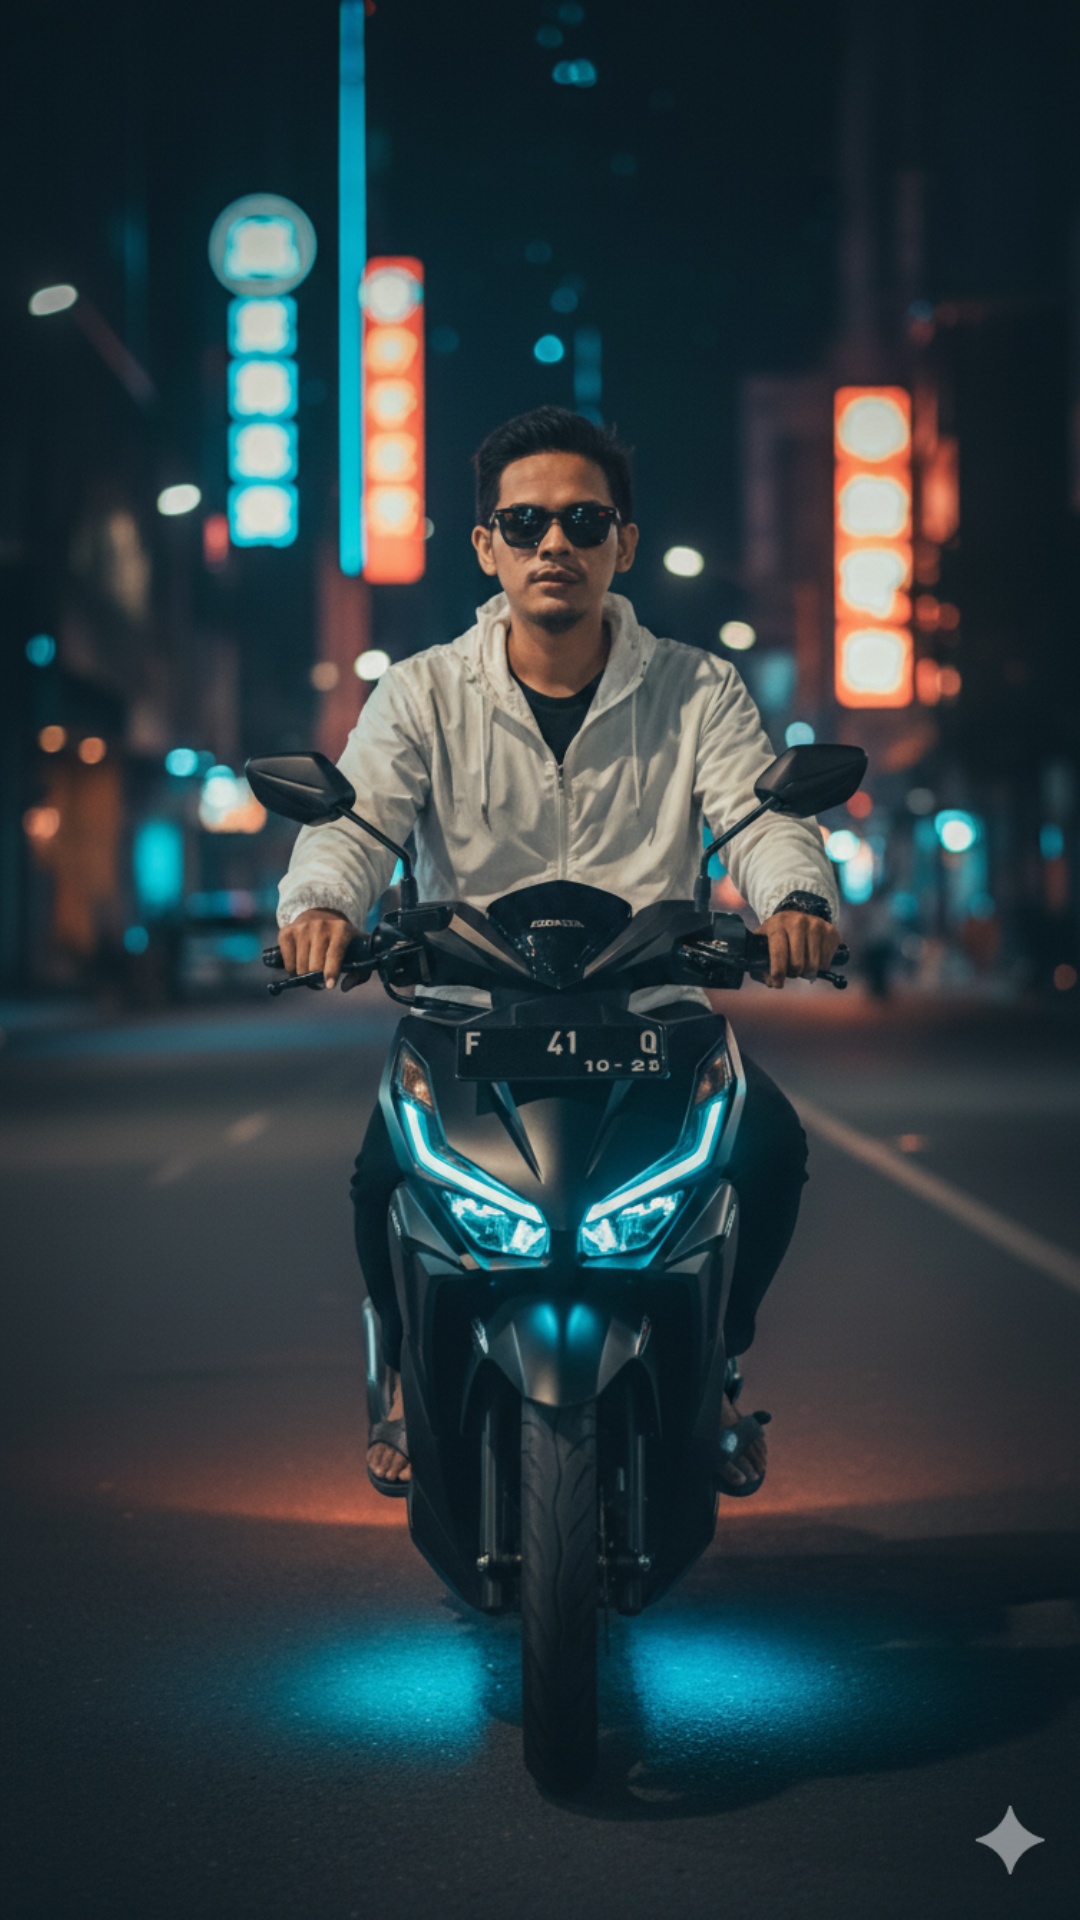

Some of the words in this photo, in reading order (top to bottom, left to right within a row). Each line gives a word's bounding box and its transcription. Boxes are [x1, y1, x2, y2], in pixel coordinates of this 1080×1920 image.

[465, 1031, 481, 1055] F
[547, 1031, 577, 1055] 41
[640, 1030, 657, 1054] Q
